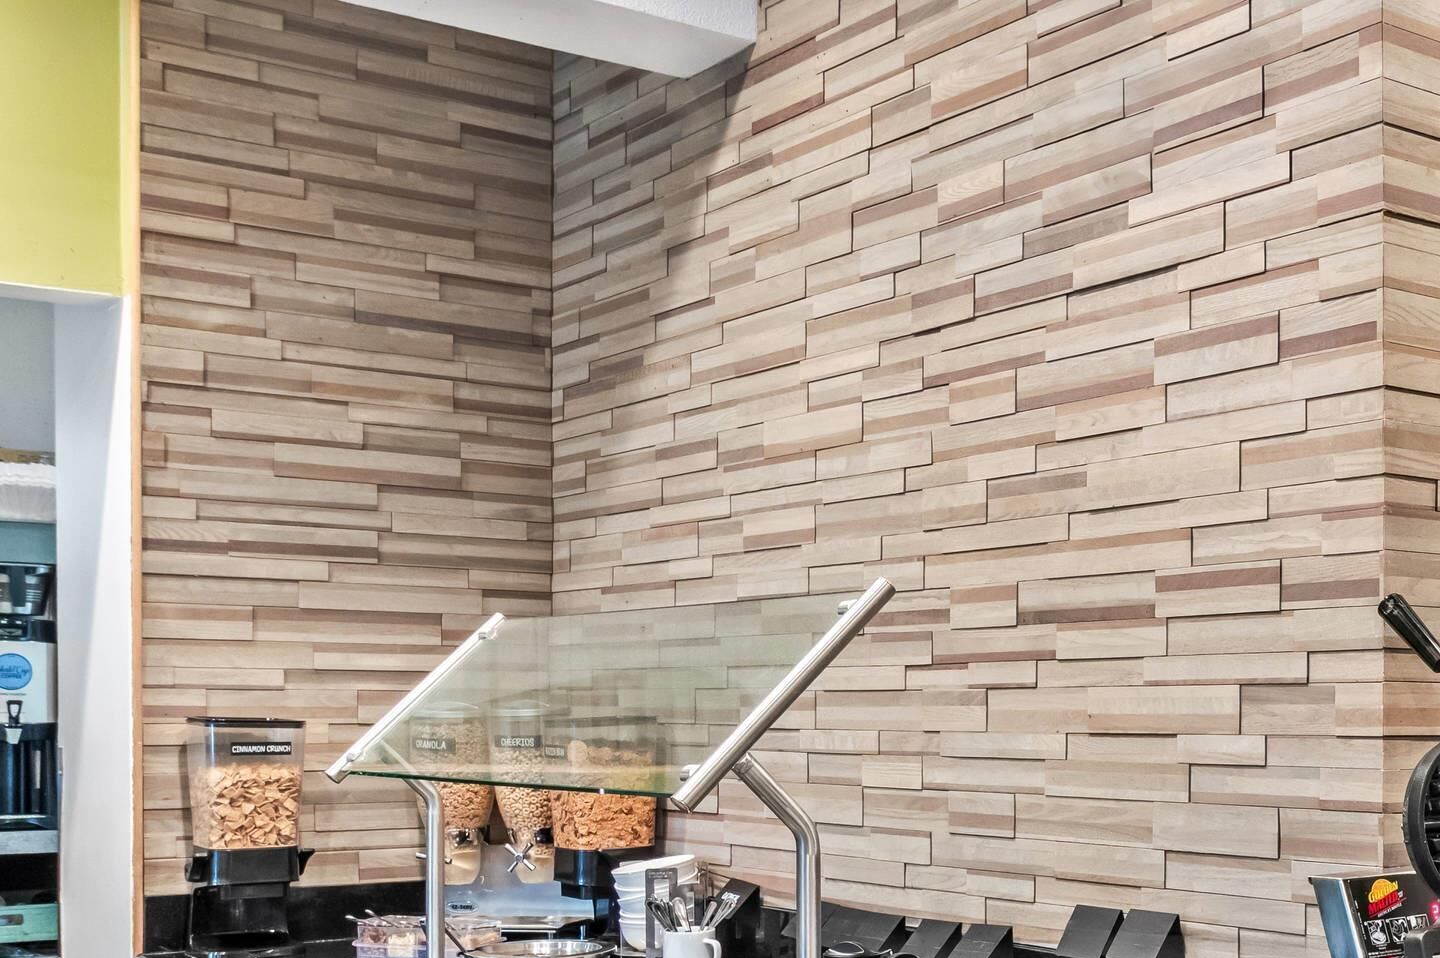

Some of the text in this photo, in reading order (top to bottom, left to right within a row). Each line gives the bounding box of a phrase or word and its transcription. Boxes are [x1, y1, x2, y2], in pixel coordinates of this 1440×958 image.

[500, 736, 535, 748] CHEERIOS
[231, 744, 291, 753] CINNAMON CRUNCH
